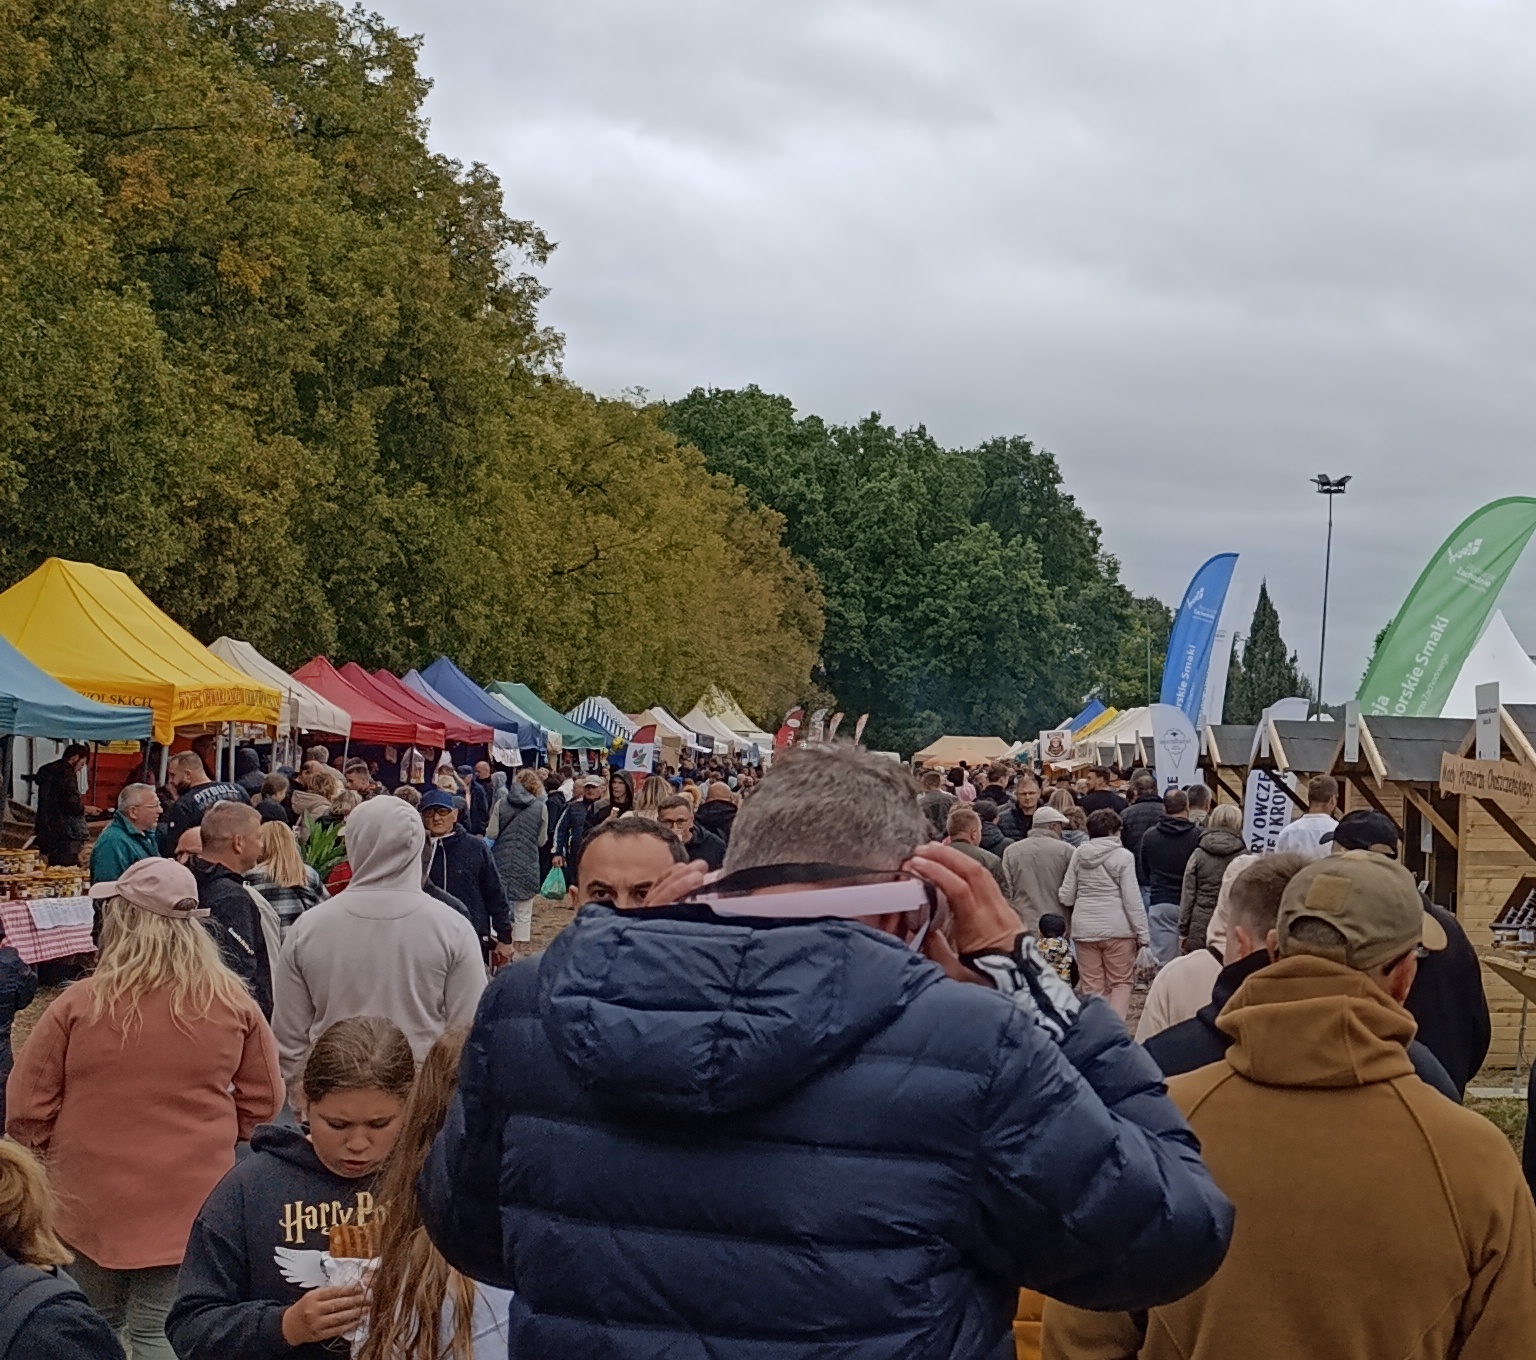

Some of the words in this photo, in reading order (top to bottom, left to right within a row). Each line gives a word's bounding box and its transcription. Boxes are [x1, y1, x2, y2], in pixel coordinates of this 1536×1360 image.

[1415, 613, 1450, 667] Smaki
[1181, 643, 1197, 683] Smaki
[82, 691, 153, 709] OLSKICH
[193, 784, 240, 804] PITBULL
[279, 1200, 354, 1244] Harry
